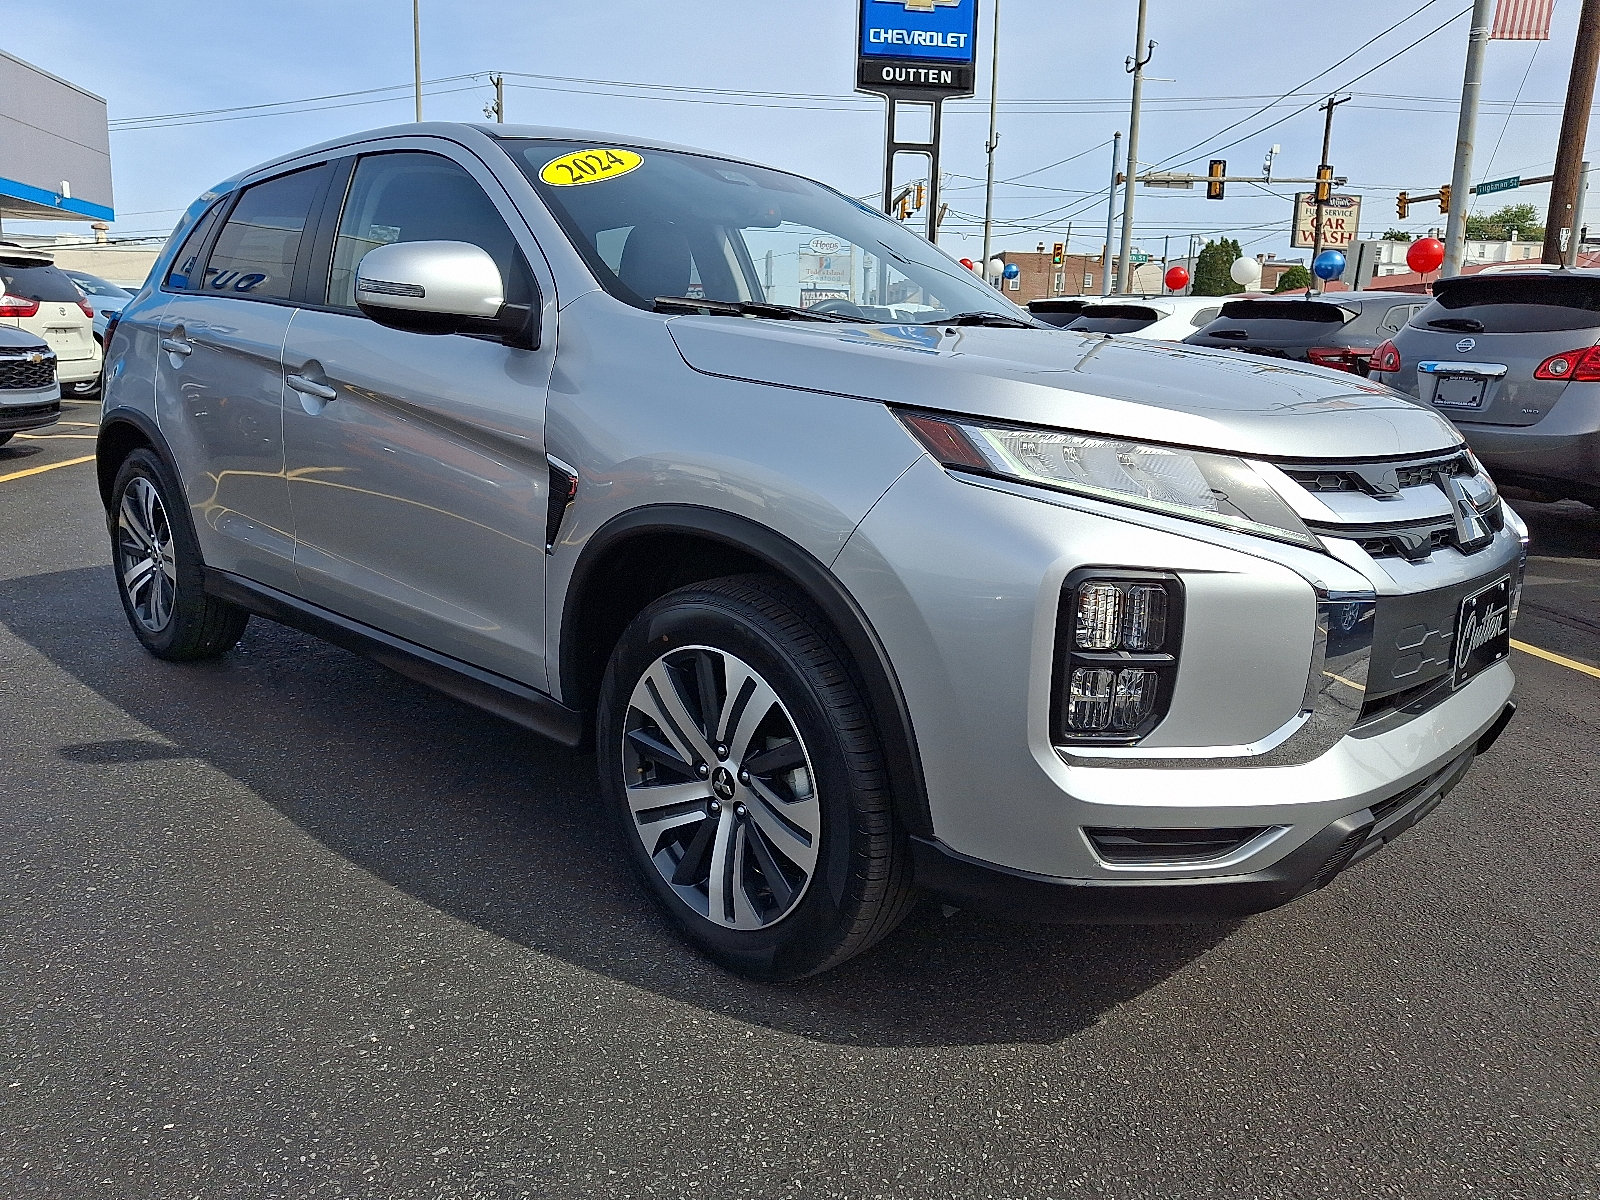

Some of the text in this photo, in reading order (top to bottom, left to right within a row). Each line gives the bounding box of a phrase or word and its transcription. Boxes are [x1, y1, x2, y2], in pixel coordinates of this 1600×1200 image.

[869, 28, 968, 48] CHEVROLET
[881, 66, 952, 84] OUTTEN
[555, 150, 625, 182] 2024
[1509, 178, 1517, 187] St
[1324, 209, 1353, 217] SERVICE
[1310, 217, 1345, 230] CAR
[1301, 230, 1352, 244] WASH
[1458, 602, 1508, 669] Outten
